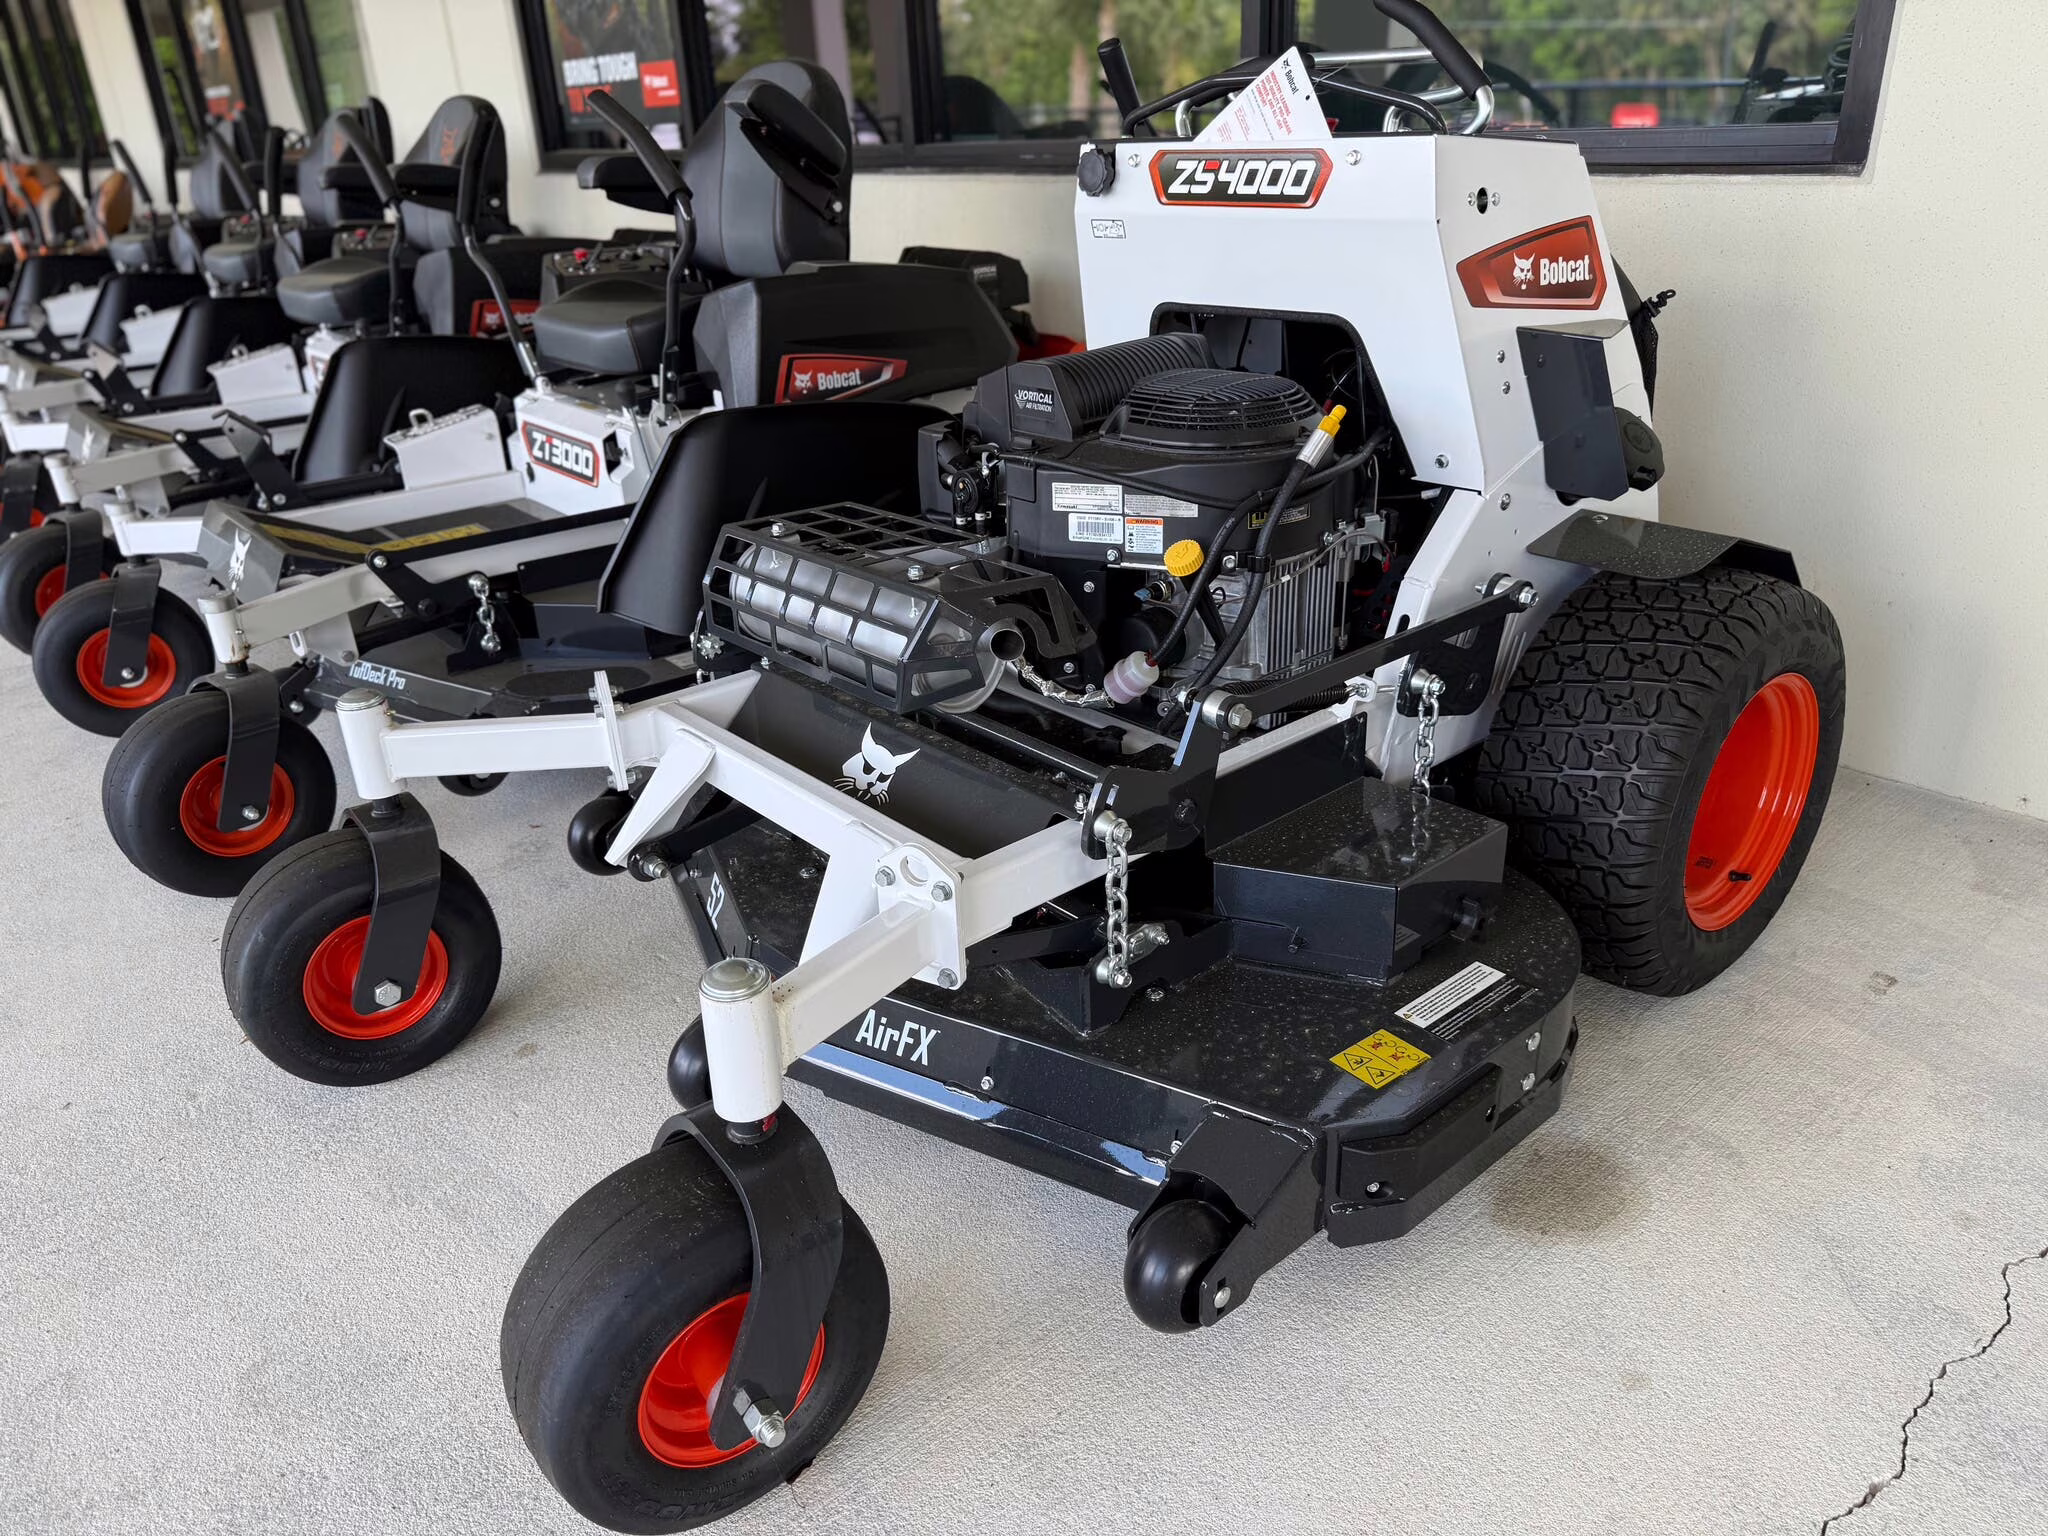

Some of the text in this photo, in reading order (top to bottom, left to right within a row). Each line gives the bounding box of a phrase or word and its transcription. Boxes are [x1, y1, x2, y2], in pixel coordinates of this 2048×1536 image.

[563, 56, 600, 86] BRING
[597, 52, 638, 83] TOUGH
[1284, 69, 1299, 94] Bobcat
[1255, 84, 1267, 106] COMFORT
[1168, 159, 1317, 195] ZS4000
[1539, 254, 1592, 286] Bobcat
[817, 368, 861, 390] Bobcat
[1018, 389, 1053, 404] VORTICAL
[532, 431, 594, 478] ZT3000
[1135, 518, 1159, 526] WARNING
[349, 661, 407, 690] TufDeck Pro
[707, 871, 725, 930] 52
[855, 1008, 936, 1066] AirFX
